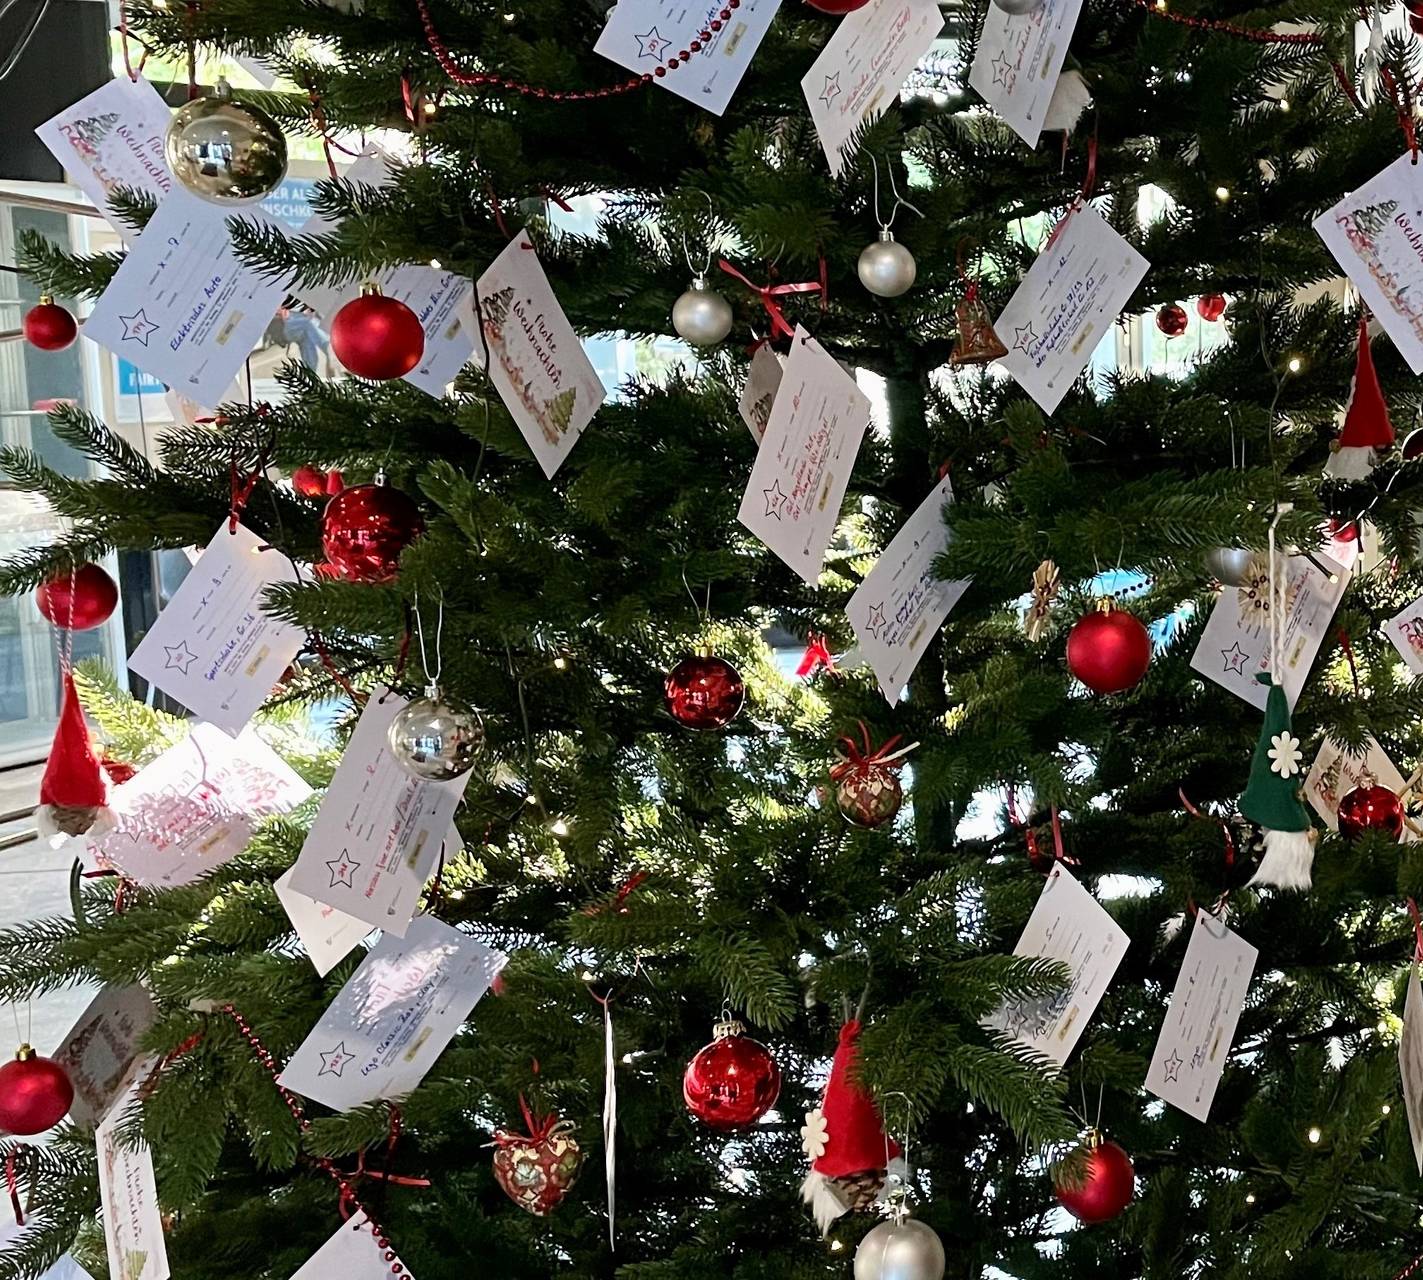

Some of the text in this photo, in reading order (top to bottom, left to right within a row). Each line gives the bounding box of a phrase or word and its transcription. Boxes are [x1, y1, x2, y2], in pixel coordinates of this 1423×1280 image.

[116, 124, 171, 193] Weihnachte
[146, 135, 166, 160] Fro
[204, 276, 222, 299] Auto
[513, 300, 561, 390] Weihnachten
[534, 313, 558, 354] Frohe
